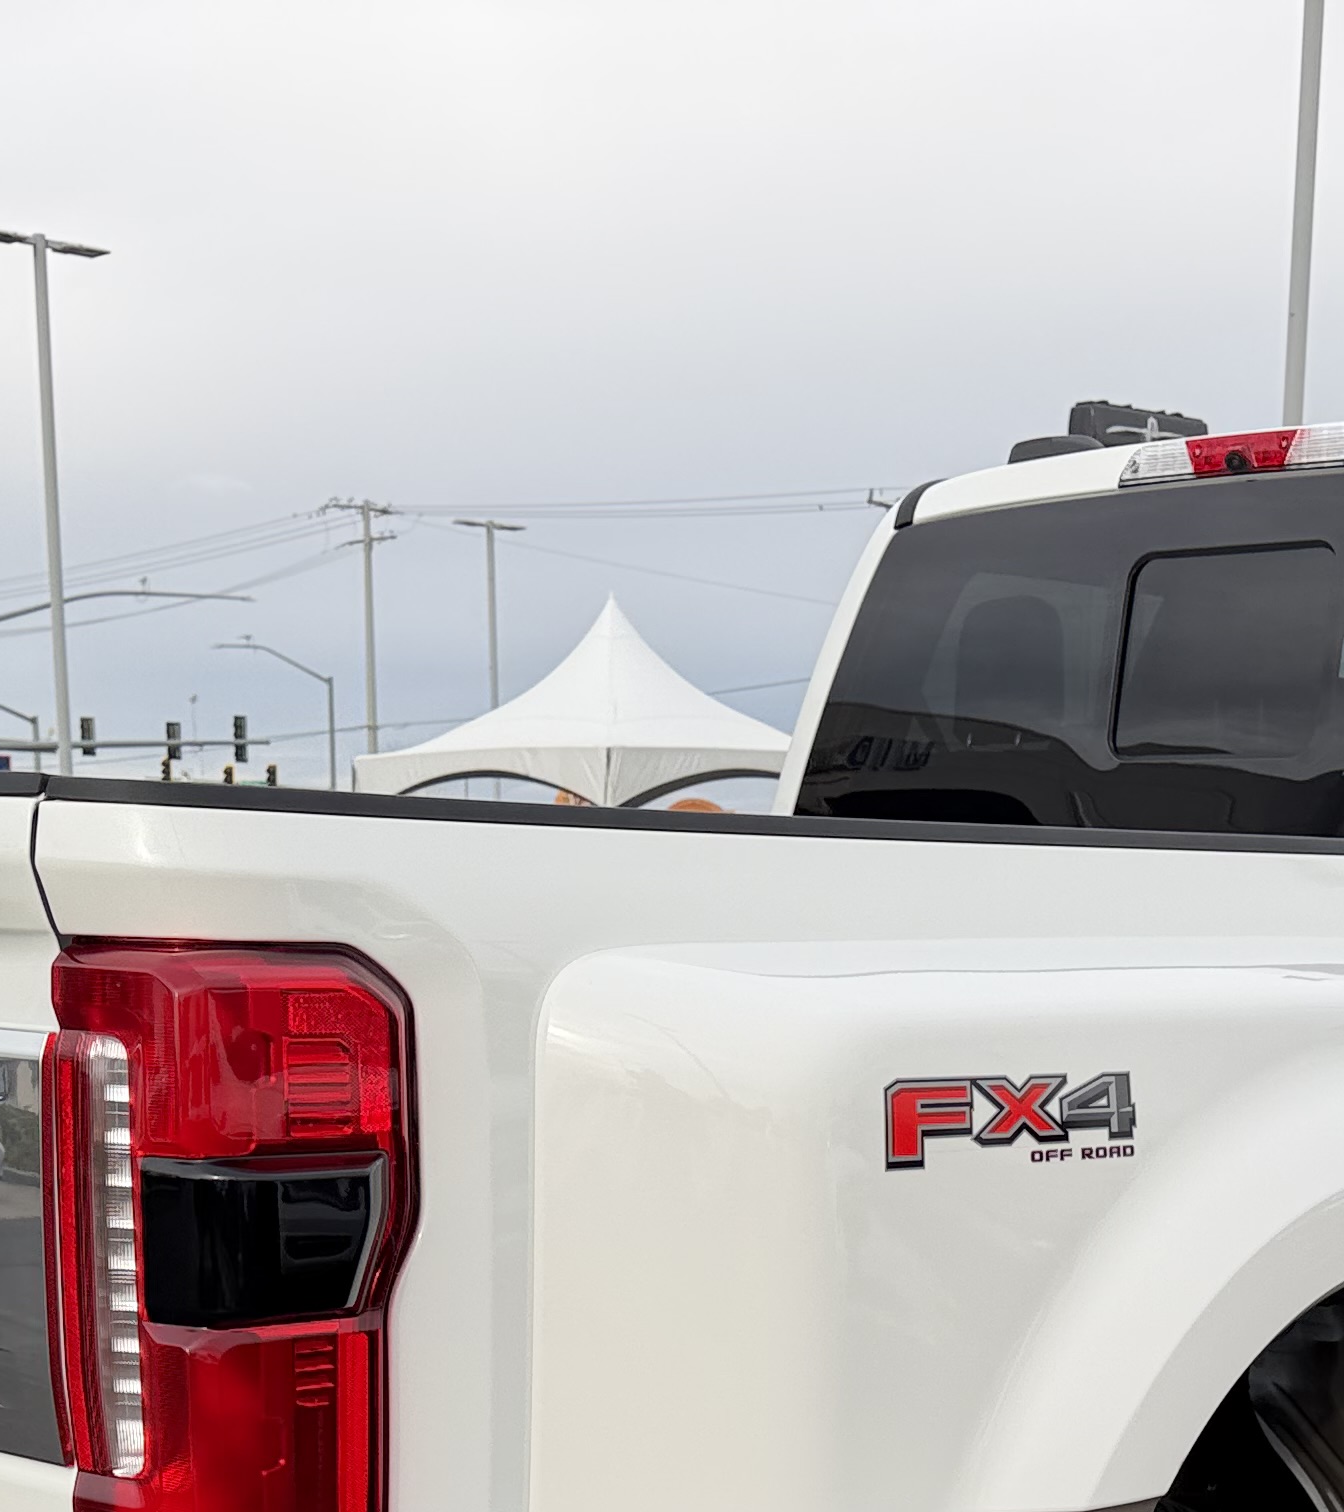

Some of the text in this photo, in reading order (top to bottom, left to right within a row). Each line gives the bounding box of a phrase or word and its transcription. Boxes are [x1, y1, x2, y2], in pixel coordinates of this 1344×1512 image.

[884, 1071, 1137, 1172] FX4
[1030, 1144, 1135, 1163] OFF ROAD
